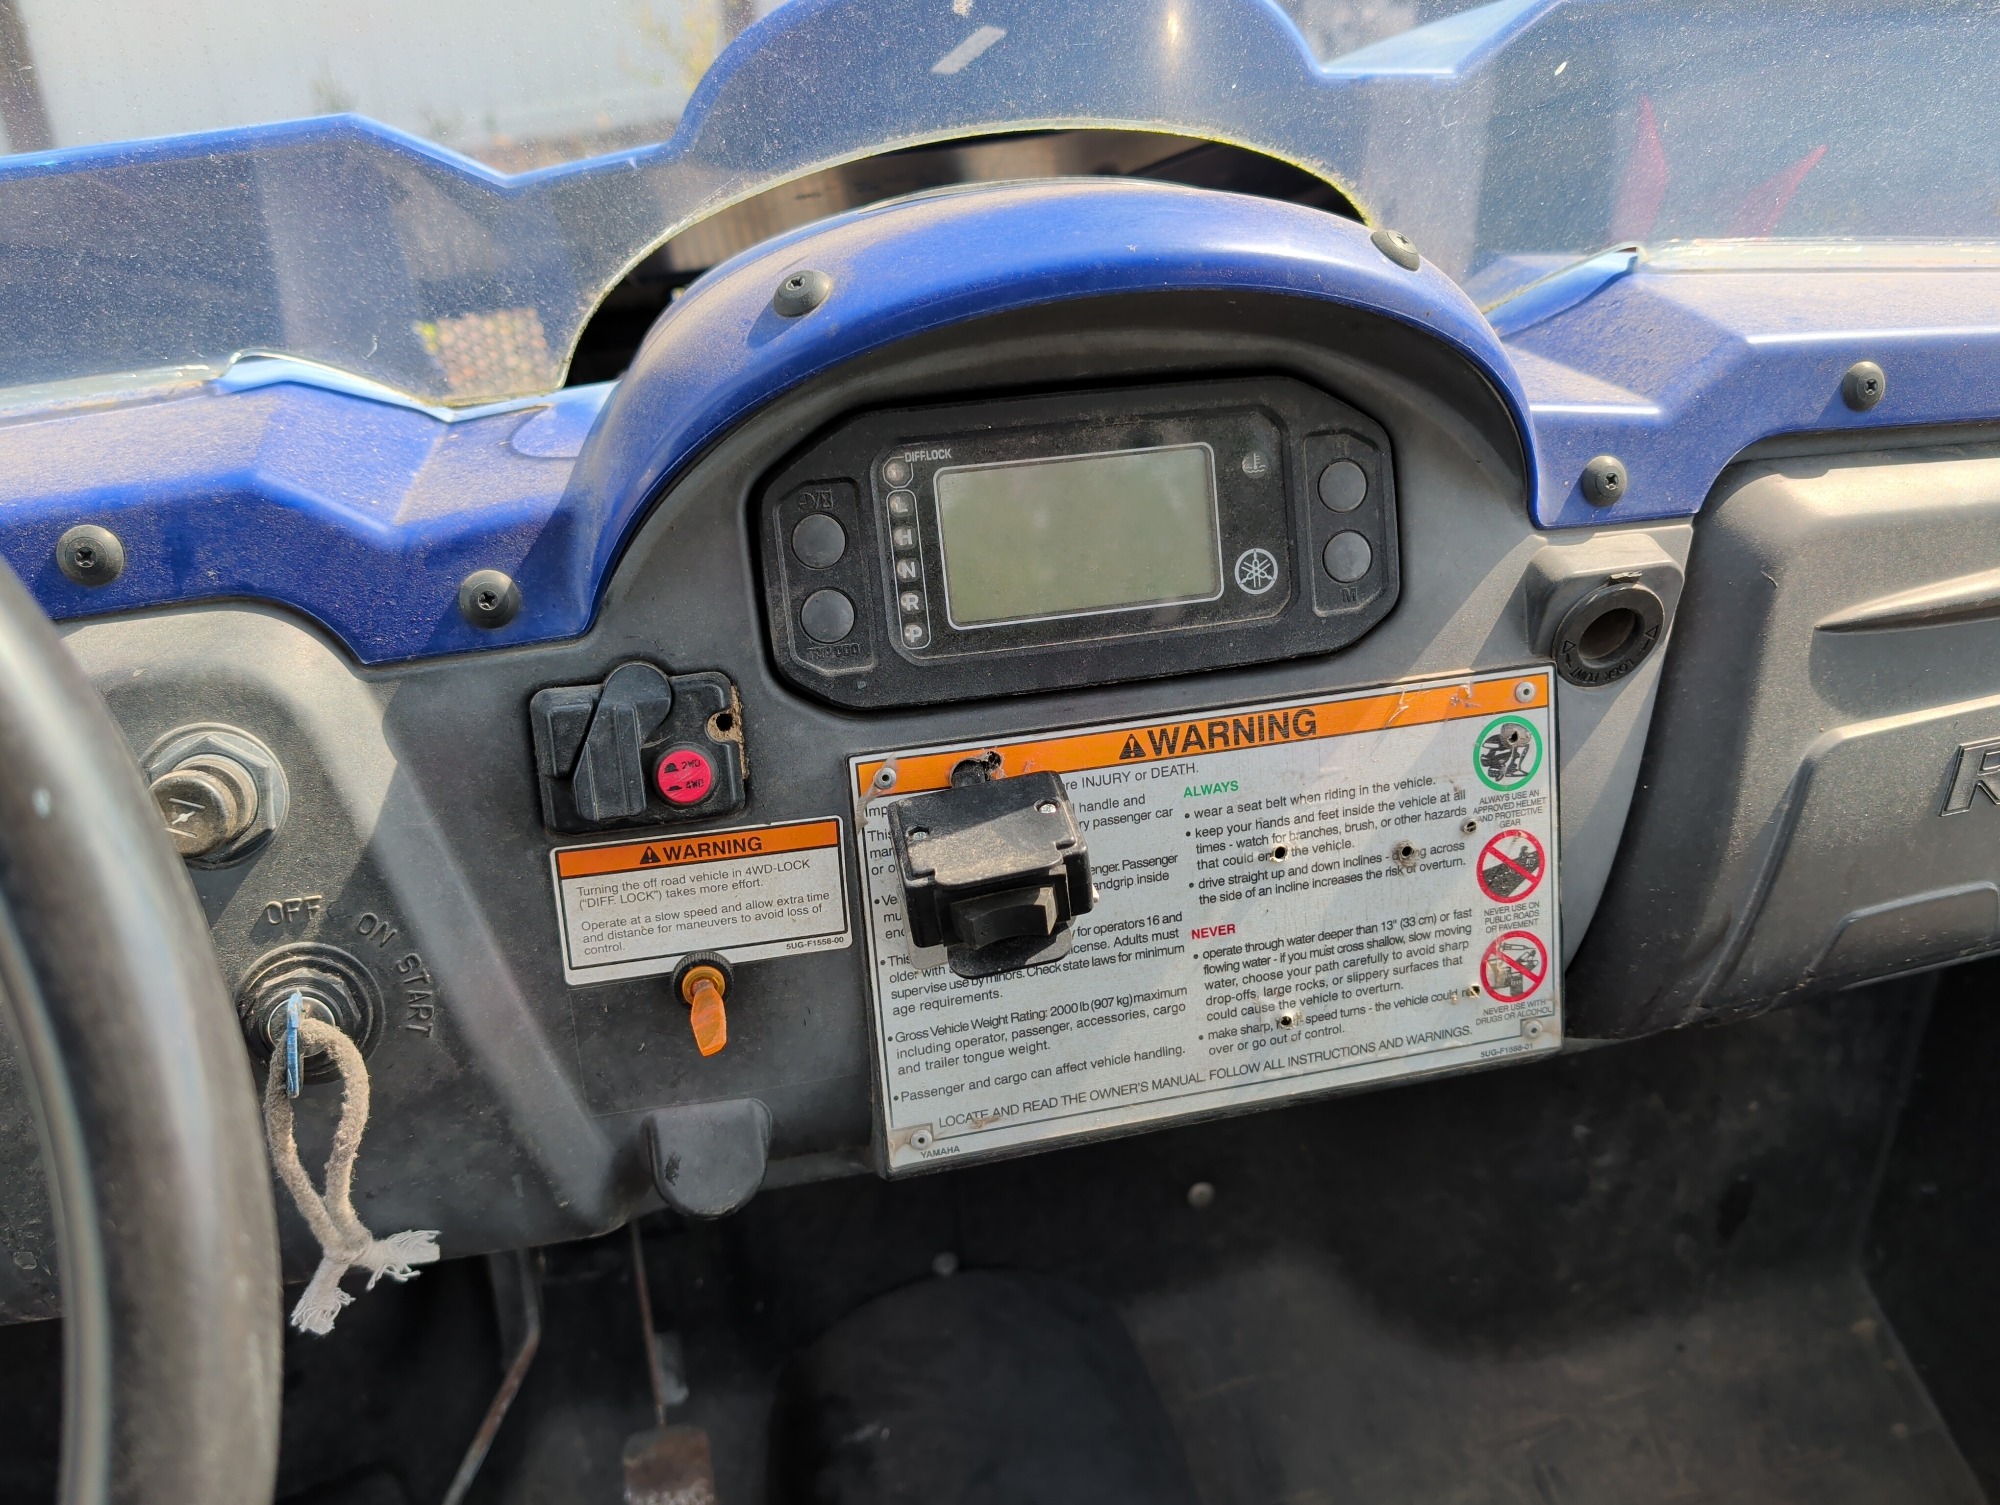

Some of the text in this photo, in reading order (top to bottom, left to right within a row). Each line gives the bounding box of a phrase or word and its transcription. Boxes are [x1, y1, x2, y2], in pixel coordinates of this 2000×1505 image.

[904, 448, 952, 463] DIFF.LOCK
[899, 498, 909, 513] L
[900, 530, 913, 545] H
[902, 562, 916, 578] N
[905, 594, 920, 611] R
[908, 627, 923, 643] P
[1148, 708, 1317, 757] WARNING
[1183, 780, 1239, 799] ALWAYS
[1193, 775, 1436, 819] wear a seat belt when riding in the vehicle.
[1479, 789, 1540, 805] ALWAYS USE AN
[1194, 788, 1466, 839] keep your hands and feet inside the vehicle at all
[1473, 796, 1547, 815] APPROVED HELMET
[1494, 806, 1543, 821] PROTECTIVE
[1499, 818, 1521, 829] GEAR
[663, 836, 763, 862] WARNING
[576, 858, 811, 897] Turning the off road vehicle in 4WD-LOCK
[665, 887, 697, 899] takes
[699, 883, 729, 894] more
[731, 877, 764, 890] effort.
[264, 895, 323, 926] OFF
[581, 892, 830, 933] Operate at a slow speed and allow extra time
[1484, 901, 1540, 916] NEVER USE ON
[1484, 909, 1540, 925] PUBLIC ROADS
[356, 911, 398, 948] ON
[582, 902, 823, 944] and distance for maneuvers to avoid loss of
[1191, 923, 1236, 940] NEVER
[1498, 917, 1539, 931] PAVEMENT
[584, 941, 625, 956] control.
[1203, 940, 1469, 991] water, choose your path carefully to avoid sharp
[1205, 955, 1463, 1007] drop-offs, large rocks, or slippery surfaces that
[397, 952, 436, 1039] START
[892, 989, 1003, 1017] age requirements.
[1206, 982, 1404, 1022] could cause the vehicle to overturn.
[894, 986, 1188, 1043] Gross Vehicle Weight Rating: 2000 lb (907 kg) maximum
[1475, 1006, 1552, 1026] DRUGS OR ALCOHOL
[1483, 999, 1546, 1016] NEVER USE WITH
[896, 1003, 1186, 1060] including operator, passenger, accessories, cargo
[897, 1039, 1051, 1076] and trailer tongue weight.
[900, 1045, 1186, 1103] Passenger and cargo can affect vehicle handling.
[938, 1025, 1472, 1128] LOCATE AND READ THE OWNER'S MANUAL. FOLLOW ALL INSTRUCTIONS AND WARNINGS.
[920, 1145, 961, 1159] YAMAHA
